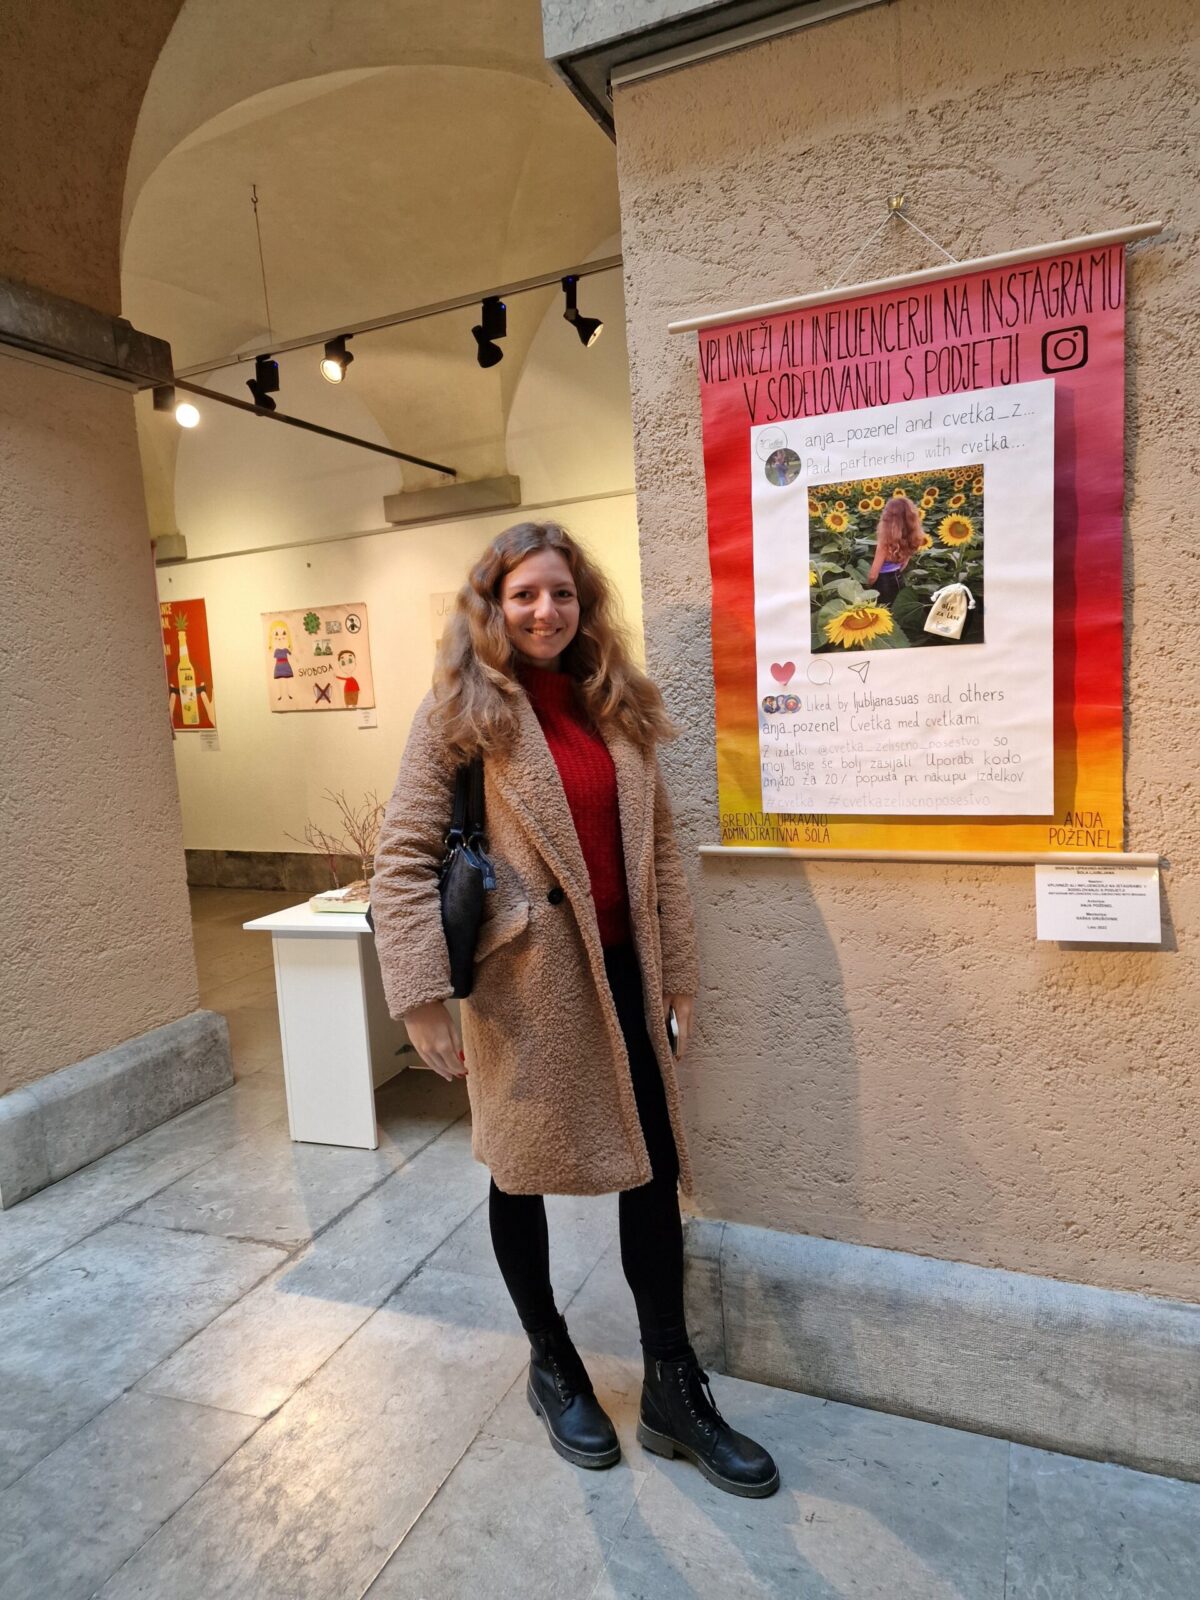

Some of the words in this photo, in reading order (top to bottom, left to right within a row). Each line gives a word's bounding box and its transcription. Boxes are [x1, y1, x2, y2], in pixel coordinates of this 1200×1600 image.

[699, 321, 772, 384] VPLIVNEŽI
[779, 319, 803, 371] ALI
[812, 294, 933, 366] INFLUENCERJI
[943, 283, 973, 341] NA
[982, 247, 1124, 334] INSTAGRAMU
[743, 379, 758, 424] V
[767, 359, 891, 421] SODELOVANJU
[902, 354, 915, 401] S
[924, 333, 1020, 399] PODJETJI
[805, 416, 898, 451] anja_pozenel
[905, 411, 932, 433] and
[806, 456, 831, 476] Paid
[840, 446, 915, 476] partnership
[925, 437, 951, 458] with
[298, 664, 333, 677] SVOBODA
[806, 694, 831, 712] Liked
[837, 695, 849, 712] by
[927, 684, 952, 704] and
[959, 683, 1005, 703] others
[762, 716, 839, 741] anja_pozenel
[850, 715, 892, 732] Cvetka
[898, 711, 920, 728] med
[993, 736, 1008, 747] so
[983, 749, 1022, 766] kodo
[801, 775, 817, 786] za
[855, 771, 897, 788] popusta
[924, 771, 966, 785] nakupu
[722, 812, 772, 829] SREDNJA
[777, 813, 829, 828] UPRAVNO
[1064, 811, 1104, 829] ANJA
[722, 826, 800, 843] ADMINISTRATIVNA
[804, 826, 831, 844] ŠOLA
